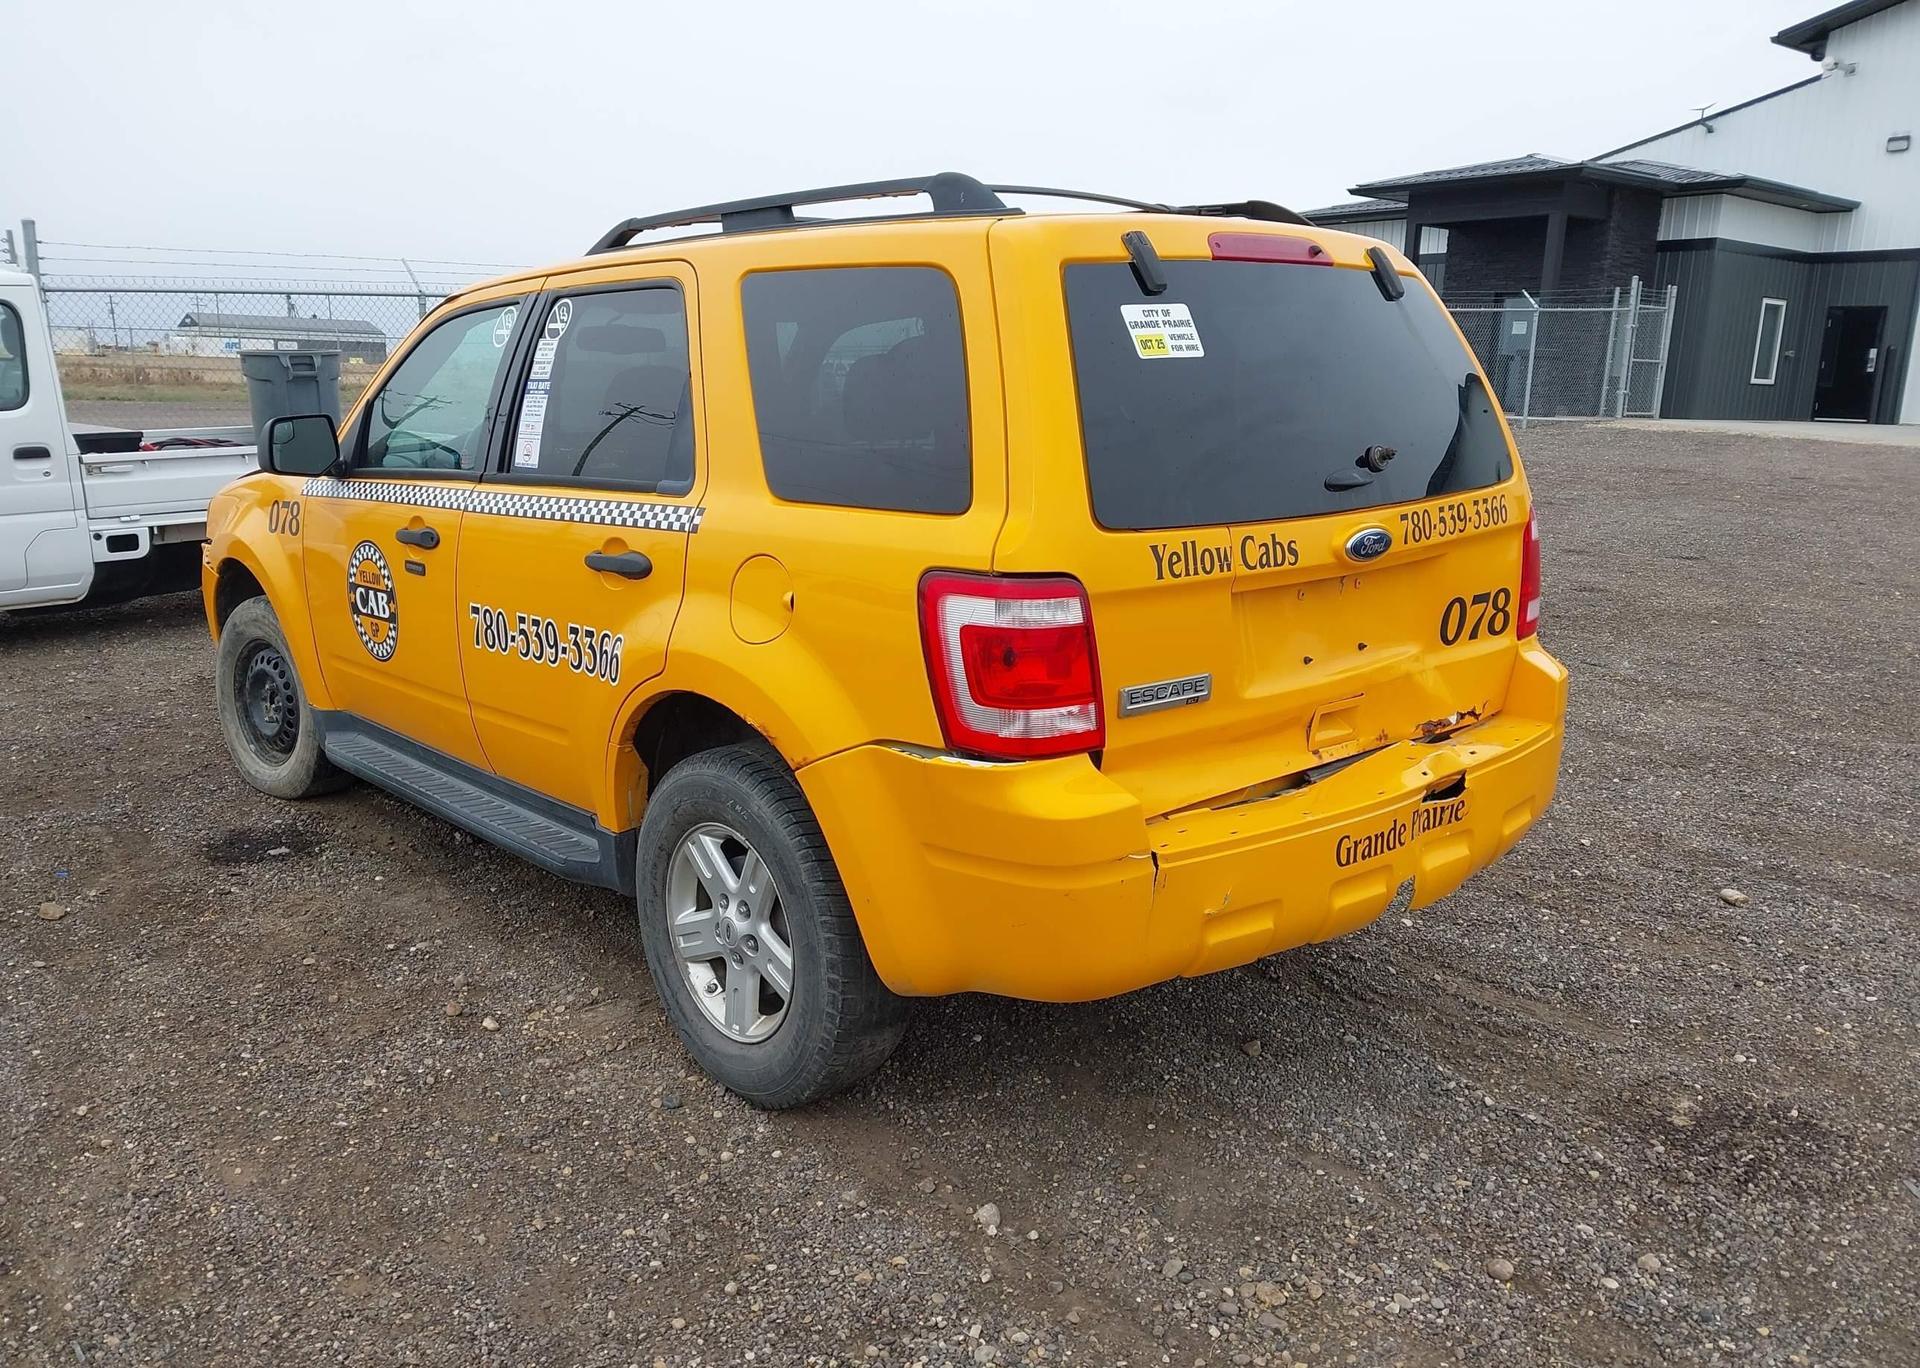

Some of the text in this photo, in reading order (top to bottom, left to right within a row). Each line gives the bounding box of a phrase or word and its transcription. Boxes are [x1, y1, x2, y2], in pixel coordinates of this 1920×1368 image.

[1128, 319, 1193, 329] GRANDE PRAIRIE
[1142, 309, 1172, 318] CITY OF
[1140, 338, 1166, 350] OCT 25
[1168, 333, 1195, 341] VEHICLE
[1184, 344, 1200, 352] HIRE
[269, 499, 300, 536] 078
[1399, 494, 1508, 545] 780-539-3366
[1360, 535, 1387, 555] Ford
[1149, 533, 1299, 580] Yellow Cabs
[359, 569, 381, 586] YELLOW
[356, 587, 390, 619] CAB
[1439, 587, 1511, 647] 078
[370, 621, 379, 637] GP
[470, 603, 624, 686] 780-539-3366
[1130, 679, 1205, 704] ESCAPE
[1336, 818, 1407, 868] Grande
